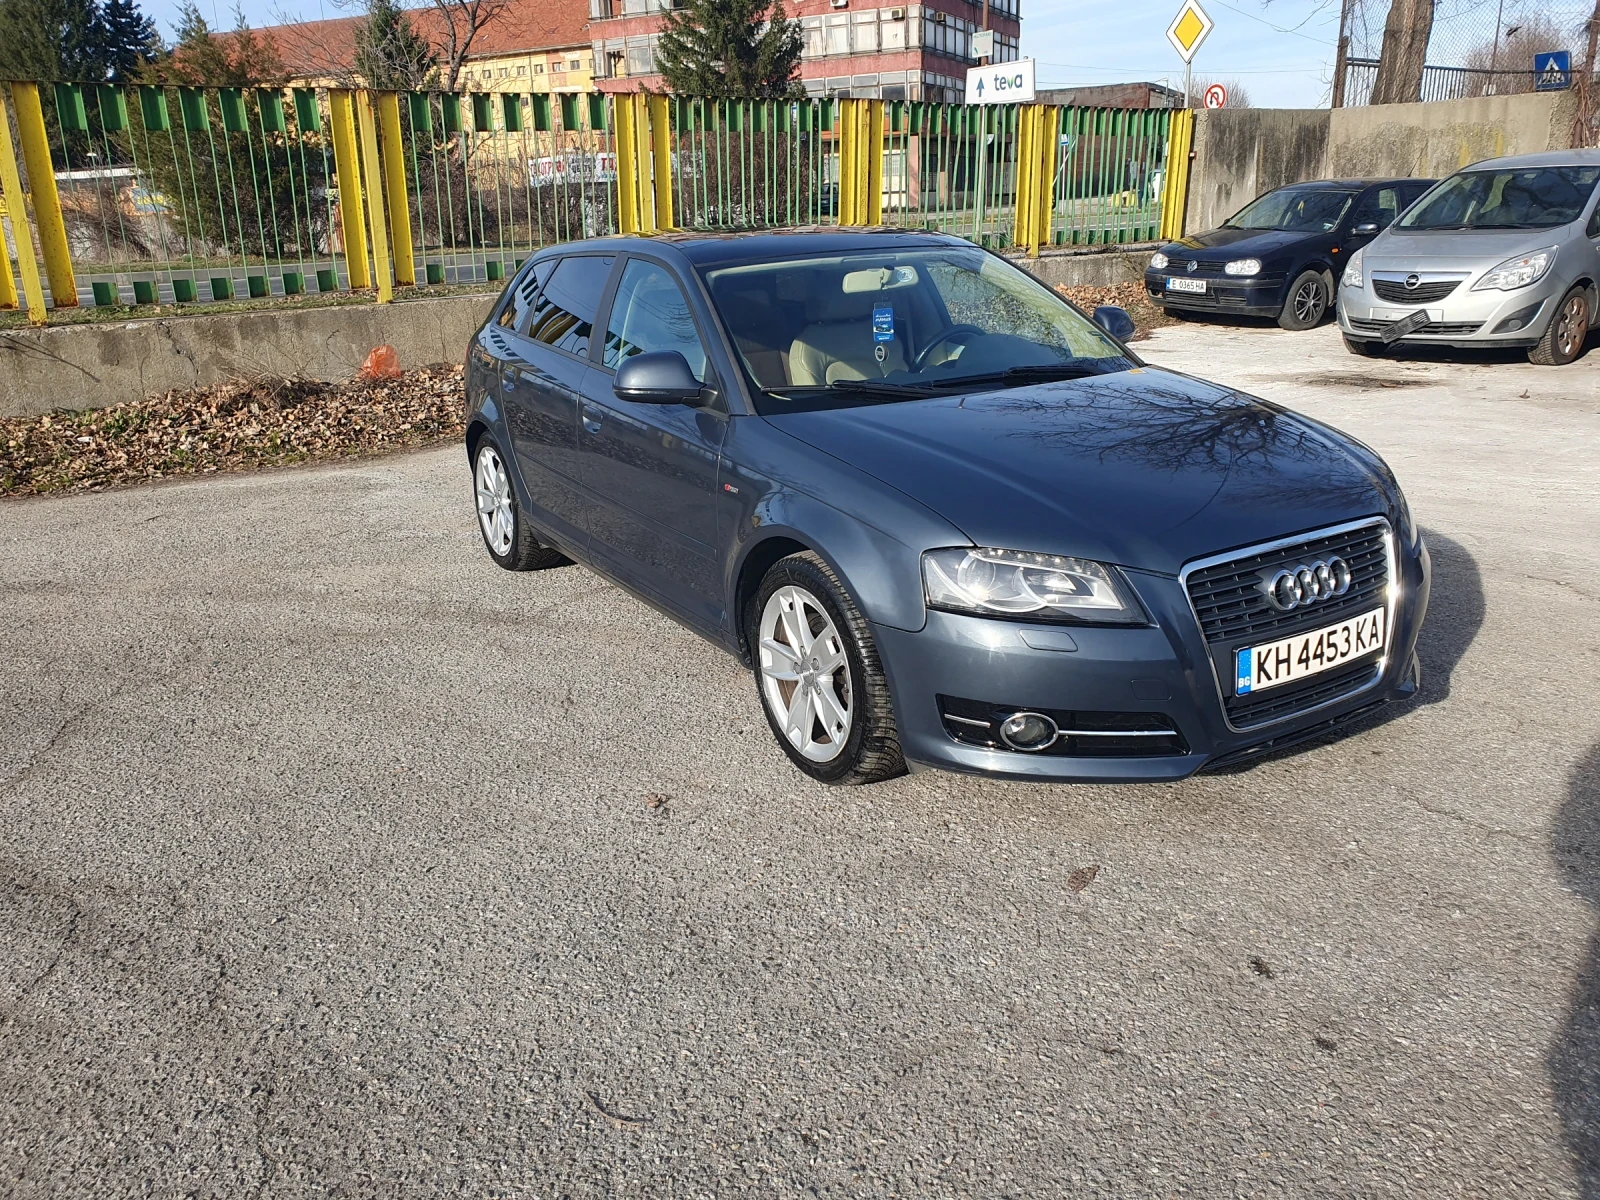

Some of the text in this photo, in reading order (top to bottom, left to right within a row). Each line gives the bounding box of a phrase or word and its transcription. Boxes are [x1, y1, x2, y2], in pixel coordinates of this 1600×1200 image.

[994, 73, 1023, 91] teva
[1172, 280, 1204, 290] E 0365 HA
[1257, 614, 1379, 684] KH 4453 KA
[1238, 675, 1251, 688] BG
